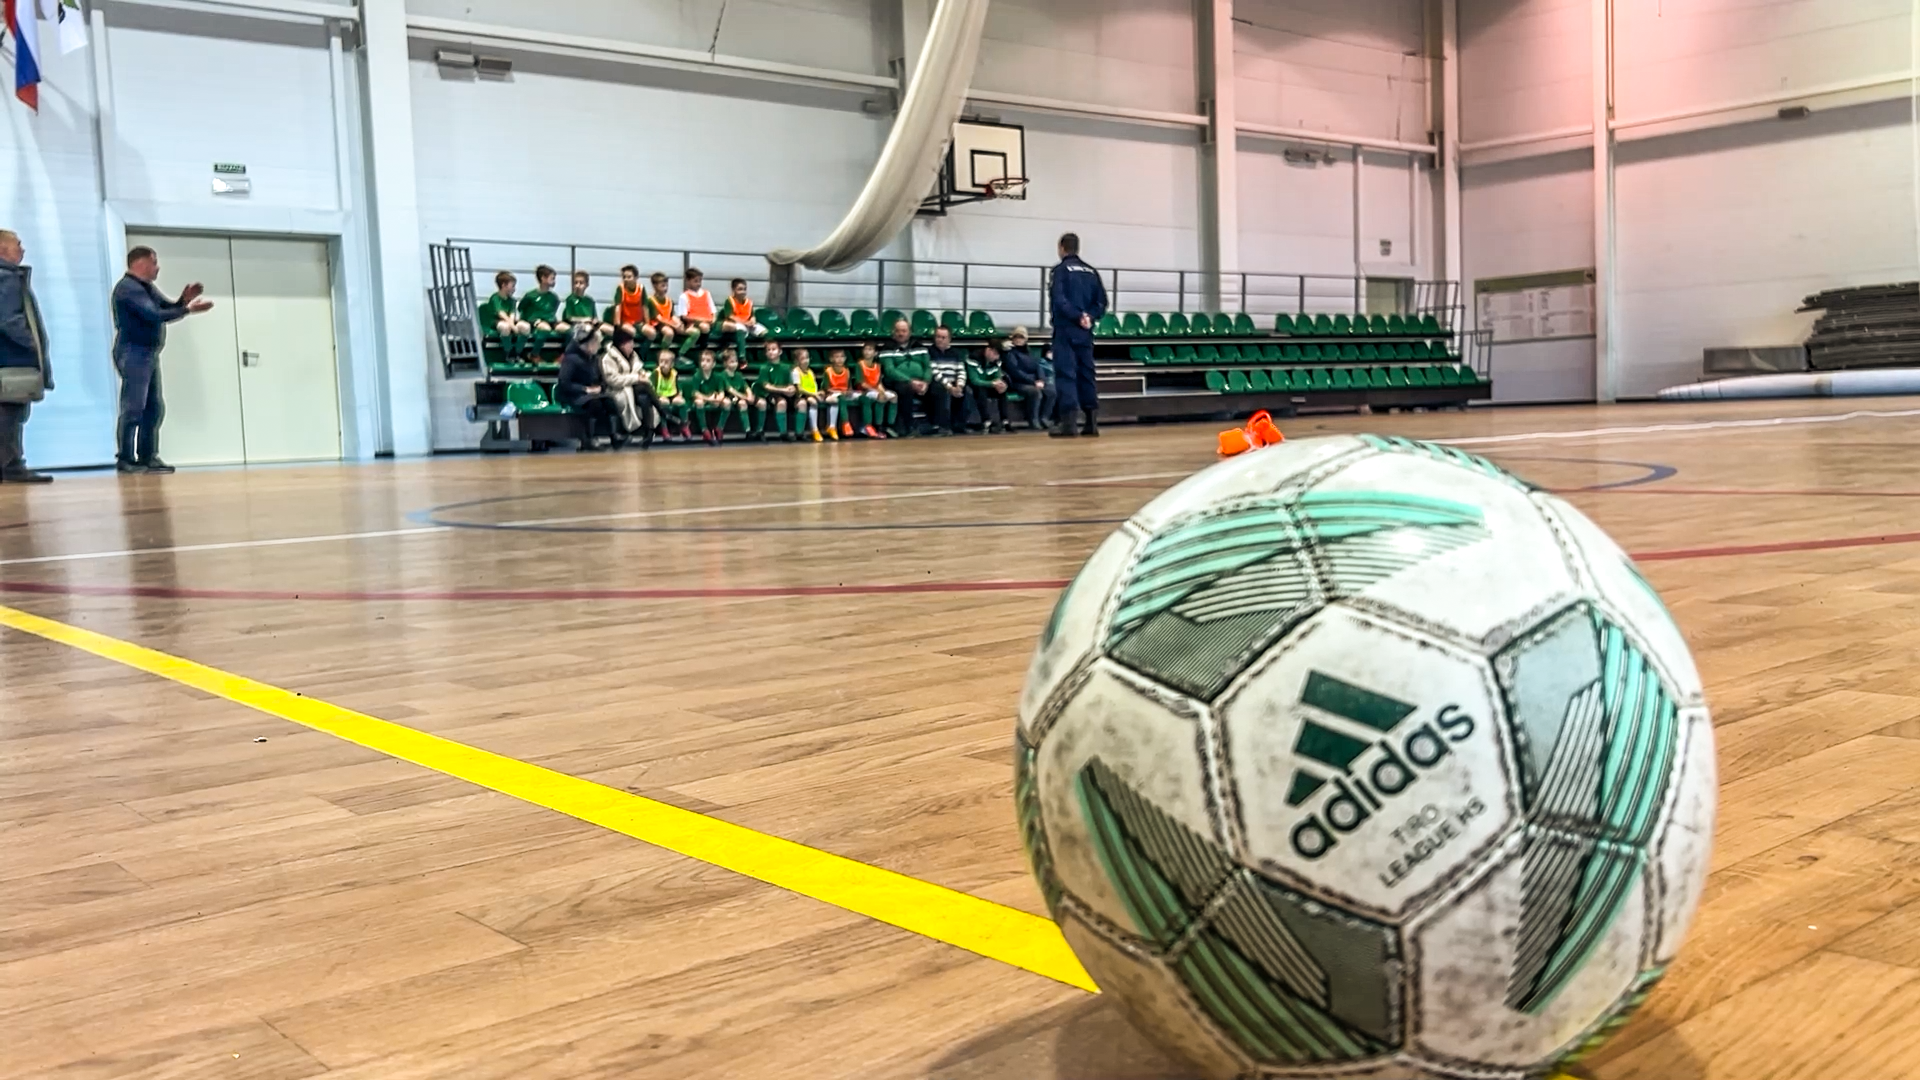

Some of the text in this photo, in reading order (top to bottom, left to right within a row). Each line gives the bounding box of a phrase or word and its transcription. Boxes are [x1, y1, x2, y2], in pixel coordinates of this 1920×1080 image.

[1289, 703, 1475, 862] adidas
[1378, 818, 1461, 889] LEAGUE
[1389, 803, 1439, 845] TIRO
